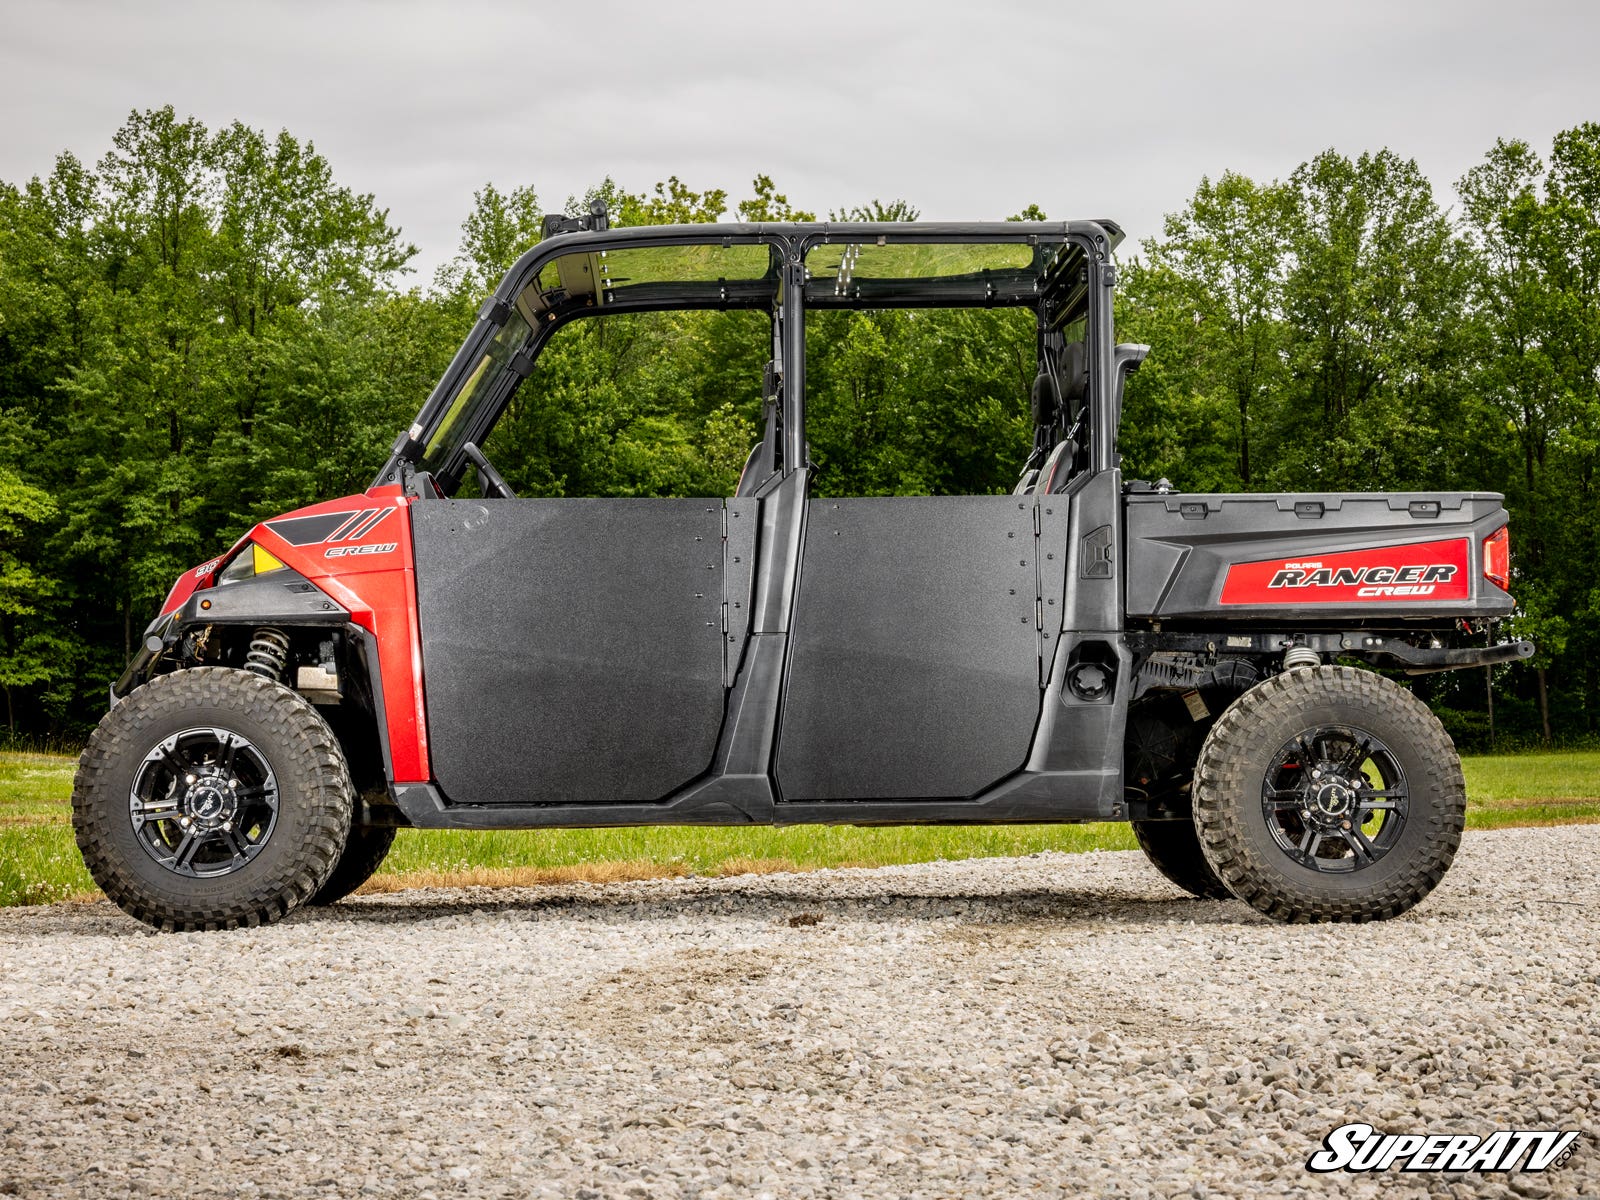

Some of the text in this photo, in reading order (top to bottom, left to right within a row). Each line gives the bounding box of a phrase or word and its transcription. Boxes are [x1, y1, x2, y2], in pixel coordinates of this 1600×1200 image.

[324, 543, 397, 557] CREW
[1268, 564, 1457, 588] RANGER
[1357, 586, 1435, 596] CREW
